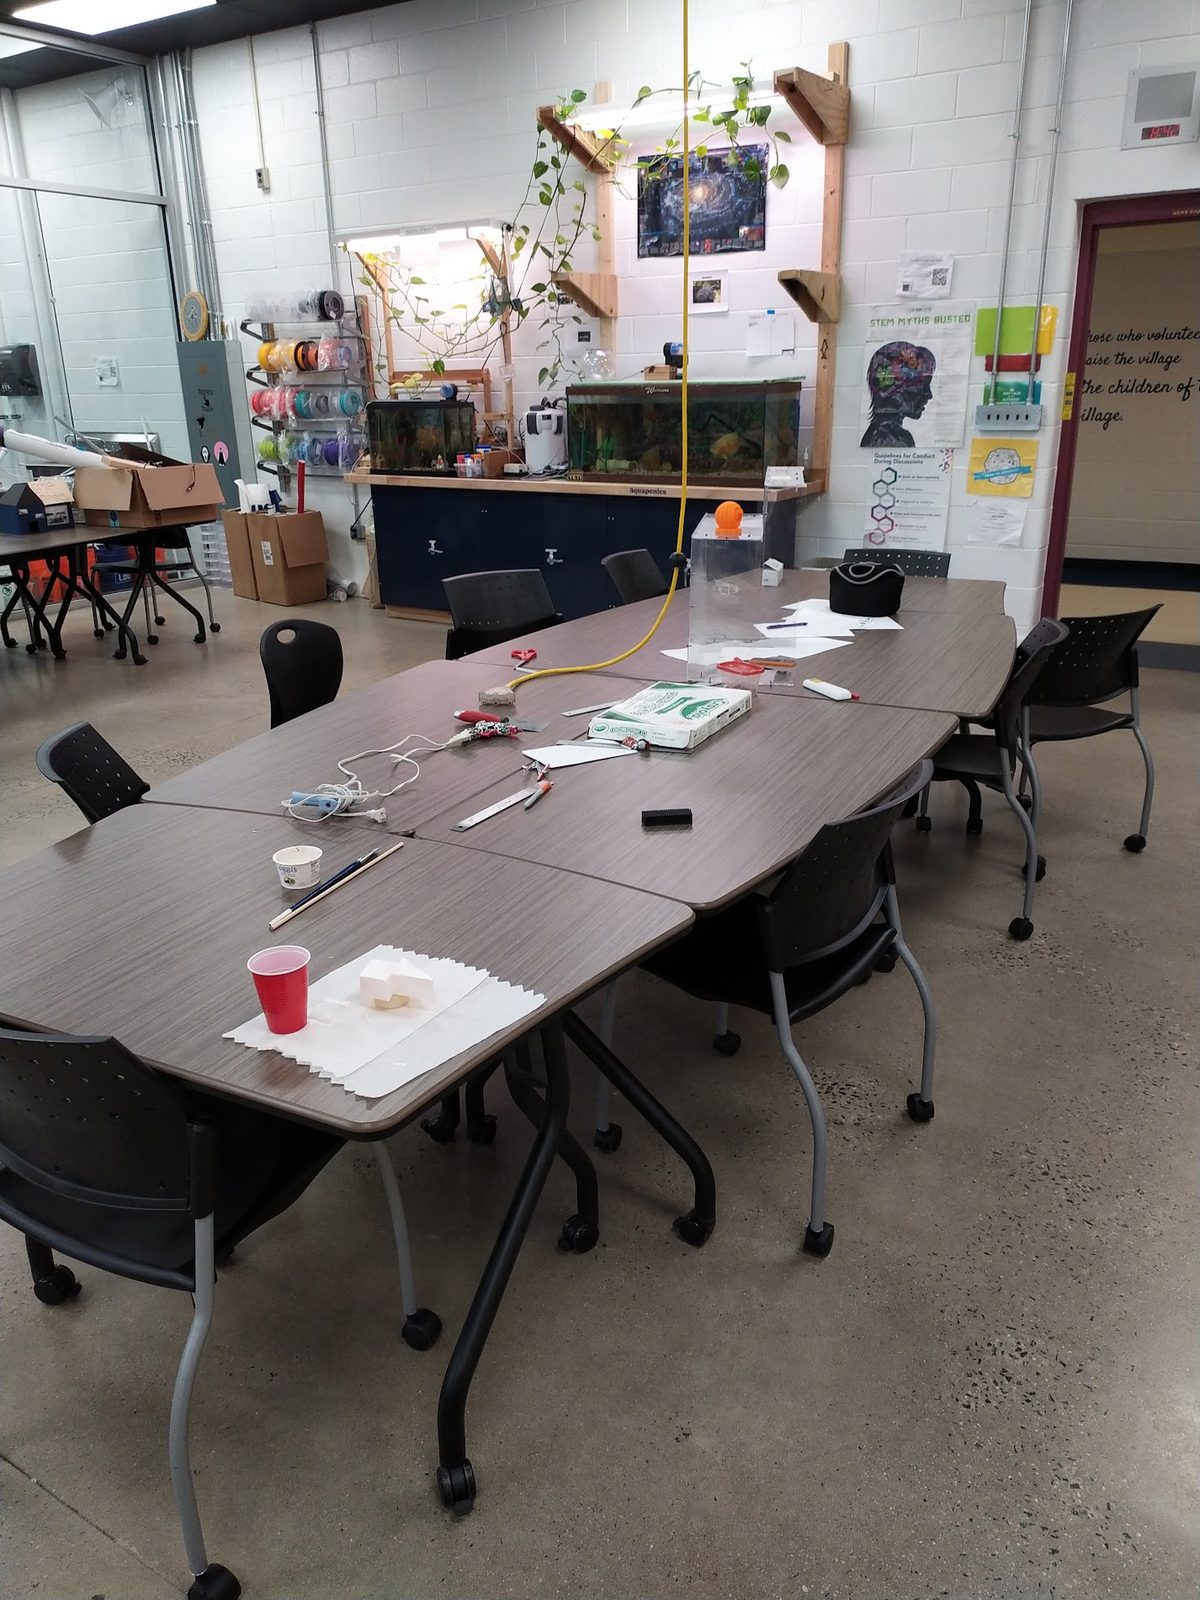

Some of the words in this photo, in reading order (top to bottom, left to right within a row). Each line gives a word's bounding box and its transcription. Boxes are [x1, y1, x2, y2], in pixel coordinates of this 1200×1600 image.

[869, 318, 895, 327] STEM
[897, 316, 930, 326] MYTHS
[933, 314, 971, 324] BUSTED
[1117, 328, 1145, 342] who
[1147, 326, 1200, 341] voluntee
[1113, 352, 1135, 365] the
[1138, 351, 1181, 371] village
[1108, 378, 1174, 394] children
[1176, 377, 1195, 401] of
[629, 487, 667, 495] Aquaponics
